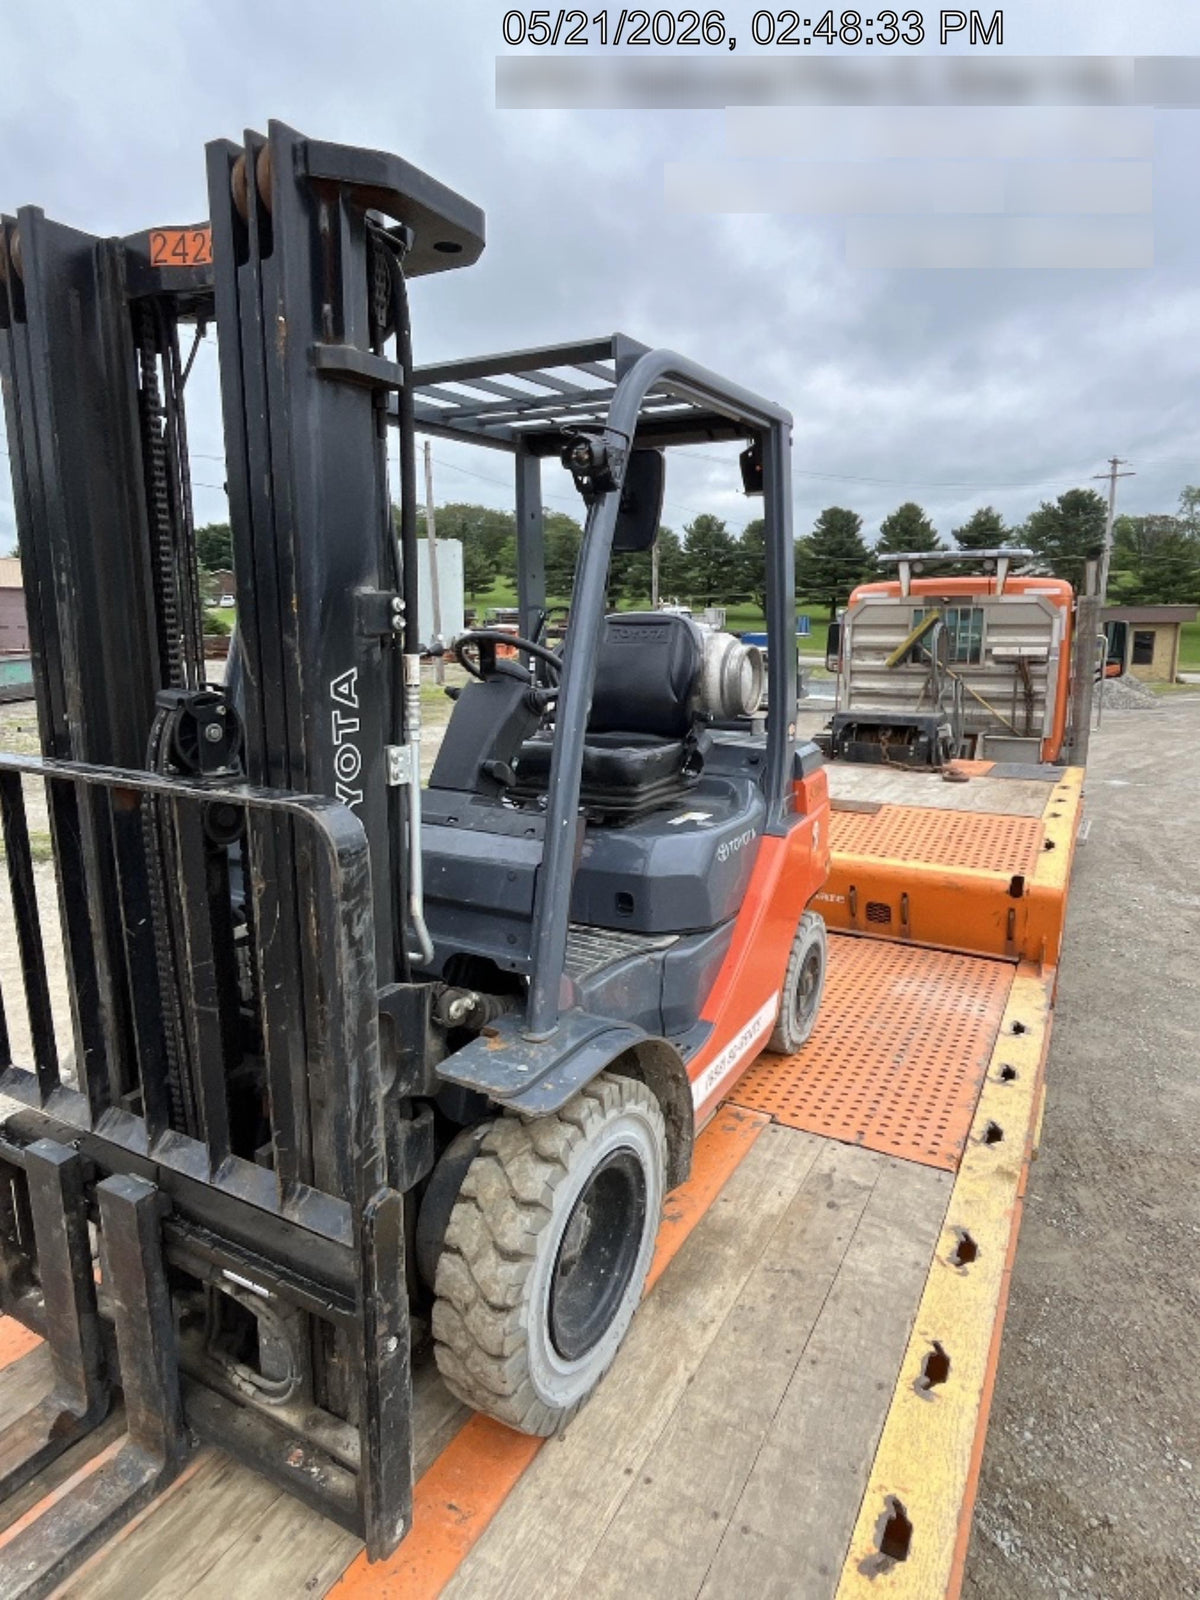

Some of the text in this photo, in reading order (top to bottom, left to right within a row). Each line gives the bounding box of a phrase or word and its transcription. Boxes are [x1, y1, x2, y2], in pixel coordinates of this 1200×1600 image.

[152, 232, 212, 263] 242
[611, 628, 665, 640] TOYOTA
[330, 666, 364, 809] YOTA
